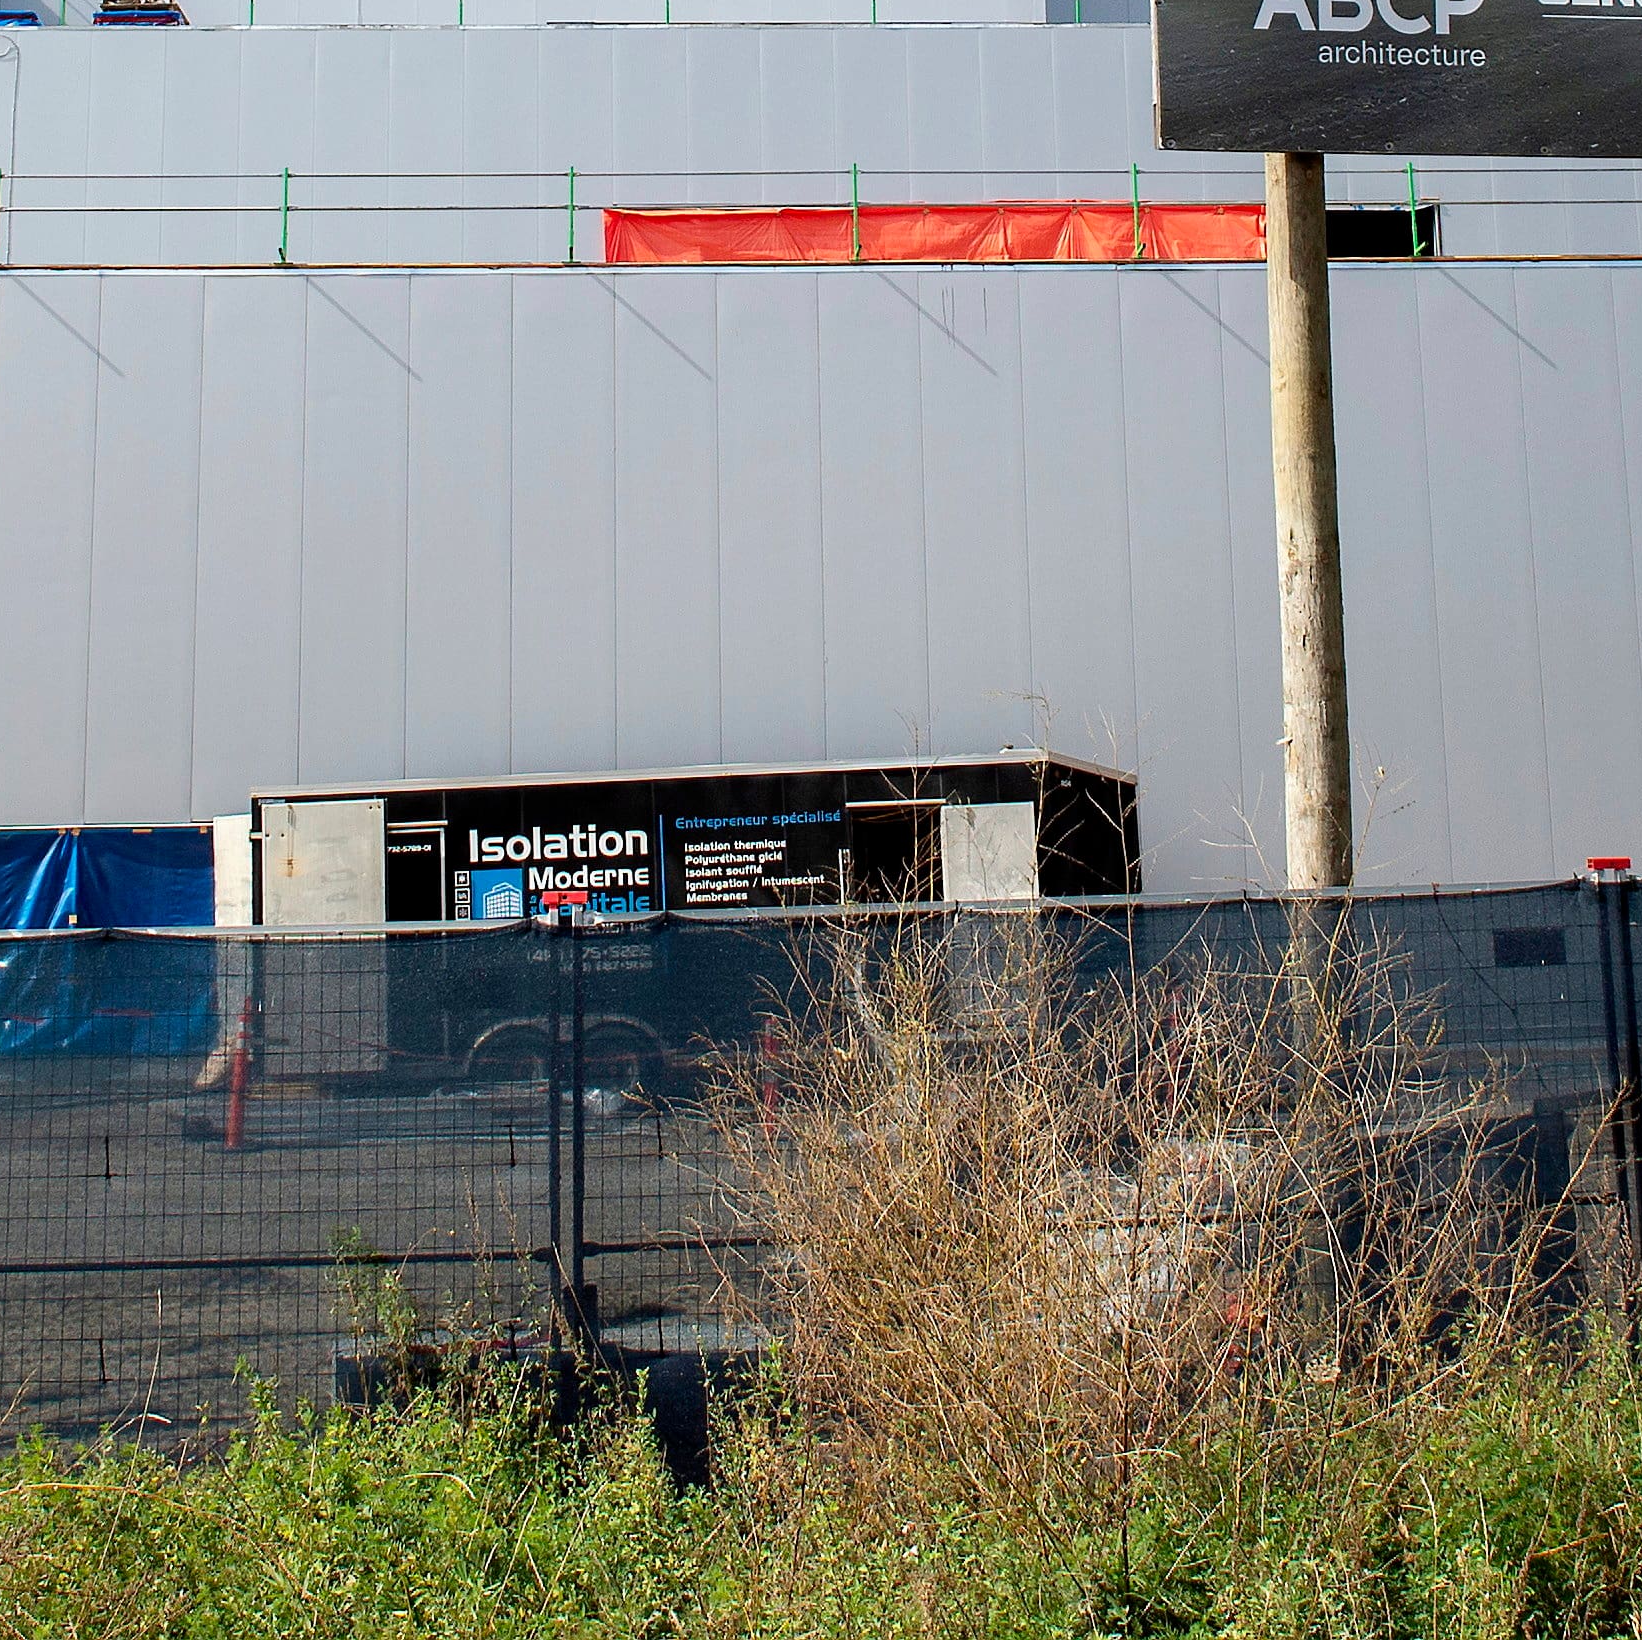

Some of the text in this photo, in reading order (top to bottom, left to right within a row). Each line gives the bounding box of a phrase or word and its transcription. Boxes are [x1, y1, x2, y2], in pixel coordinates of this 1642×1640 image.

[1317, 40, 1487, 67] architecture
[675, 809, 842, 830] Entrepreneur spécialisé
[469, 824, 649, 863] Isolation
[684, 838, 787, 852] Isolation thermique
[684, 852, 756, 866] Polyuréthane
[528, 865, 650, 890] Moderne
[685, 864, 763, 878] Isolant soufflé
[685, 878, 749, 892] Ignifugation
[761, 873, 825, 887] Intumescent
[539, 891, 650, 916] aitale
[686, 891, 748, 903] Membranes
